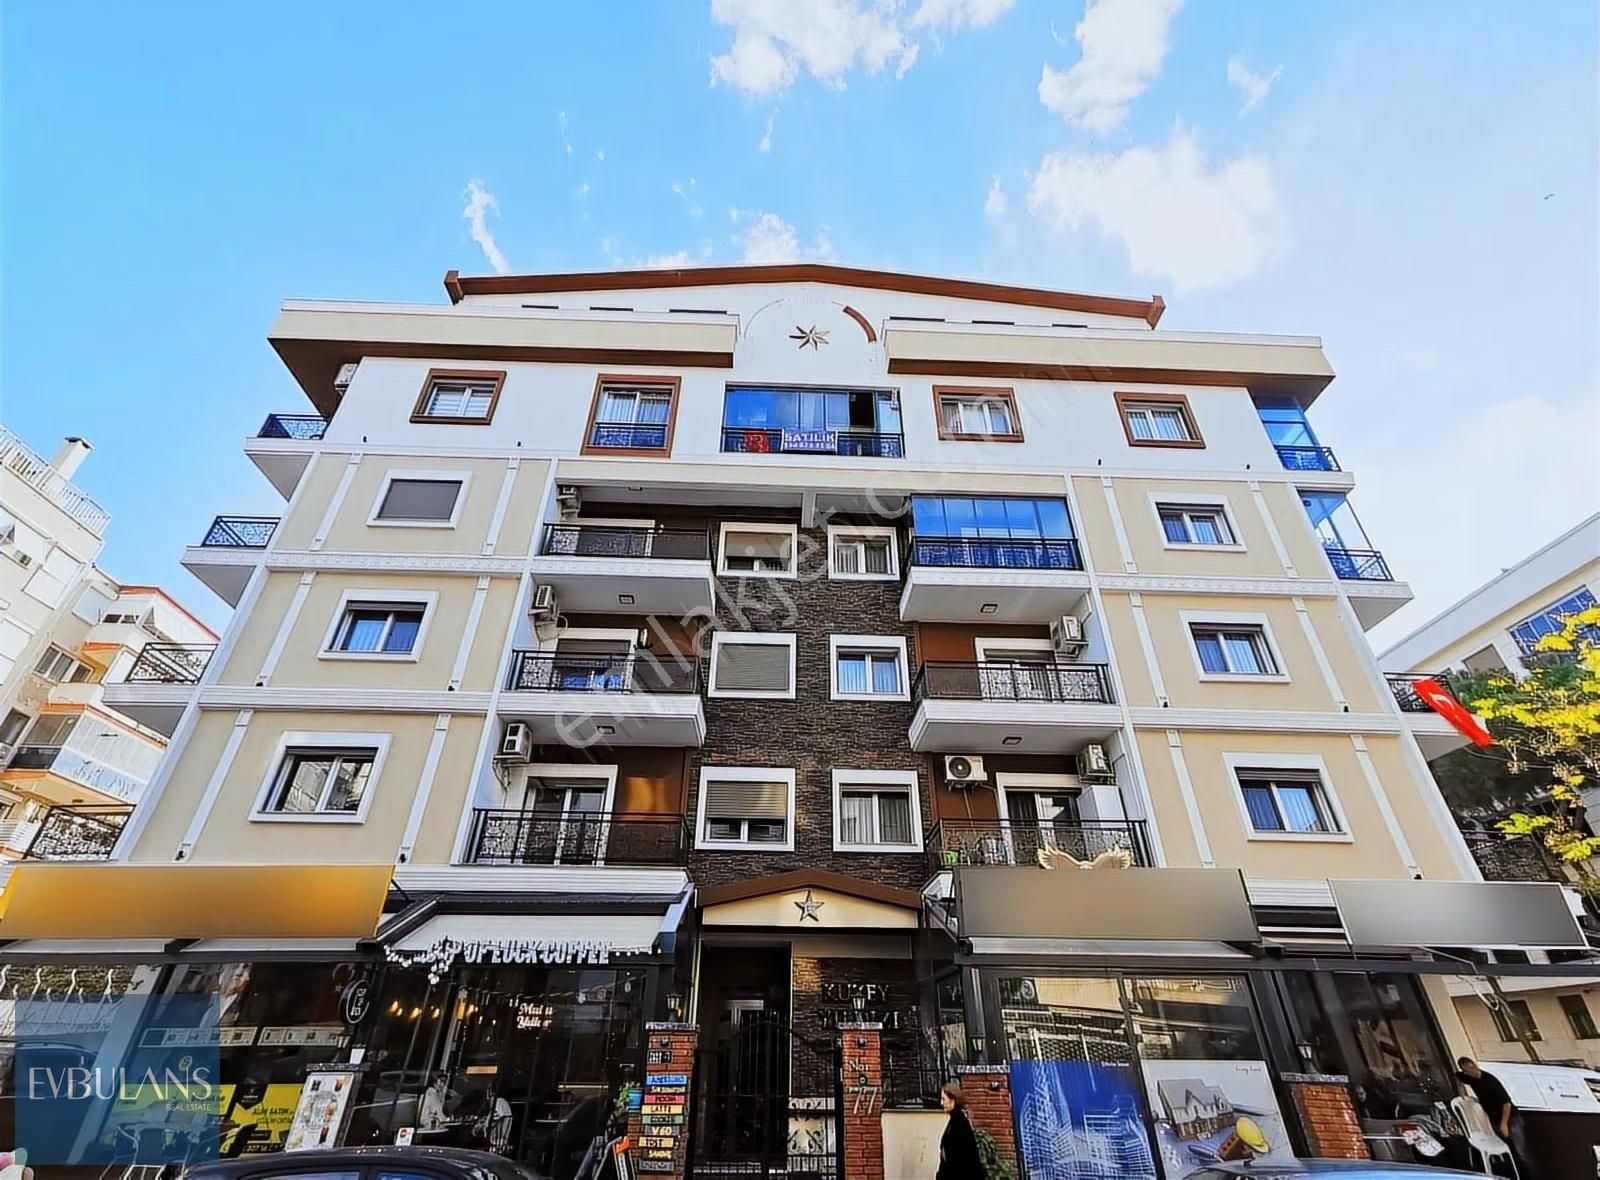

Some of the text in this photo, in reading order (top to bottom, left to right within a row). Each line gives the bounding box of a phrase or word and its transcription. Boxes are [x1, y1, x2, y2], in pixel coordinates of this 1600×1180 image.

[784, 432, 834, 442] SATILIK
[848, 1087, 880, 1114] 77
[651, 1126, 672, 1136] V60
